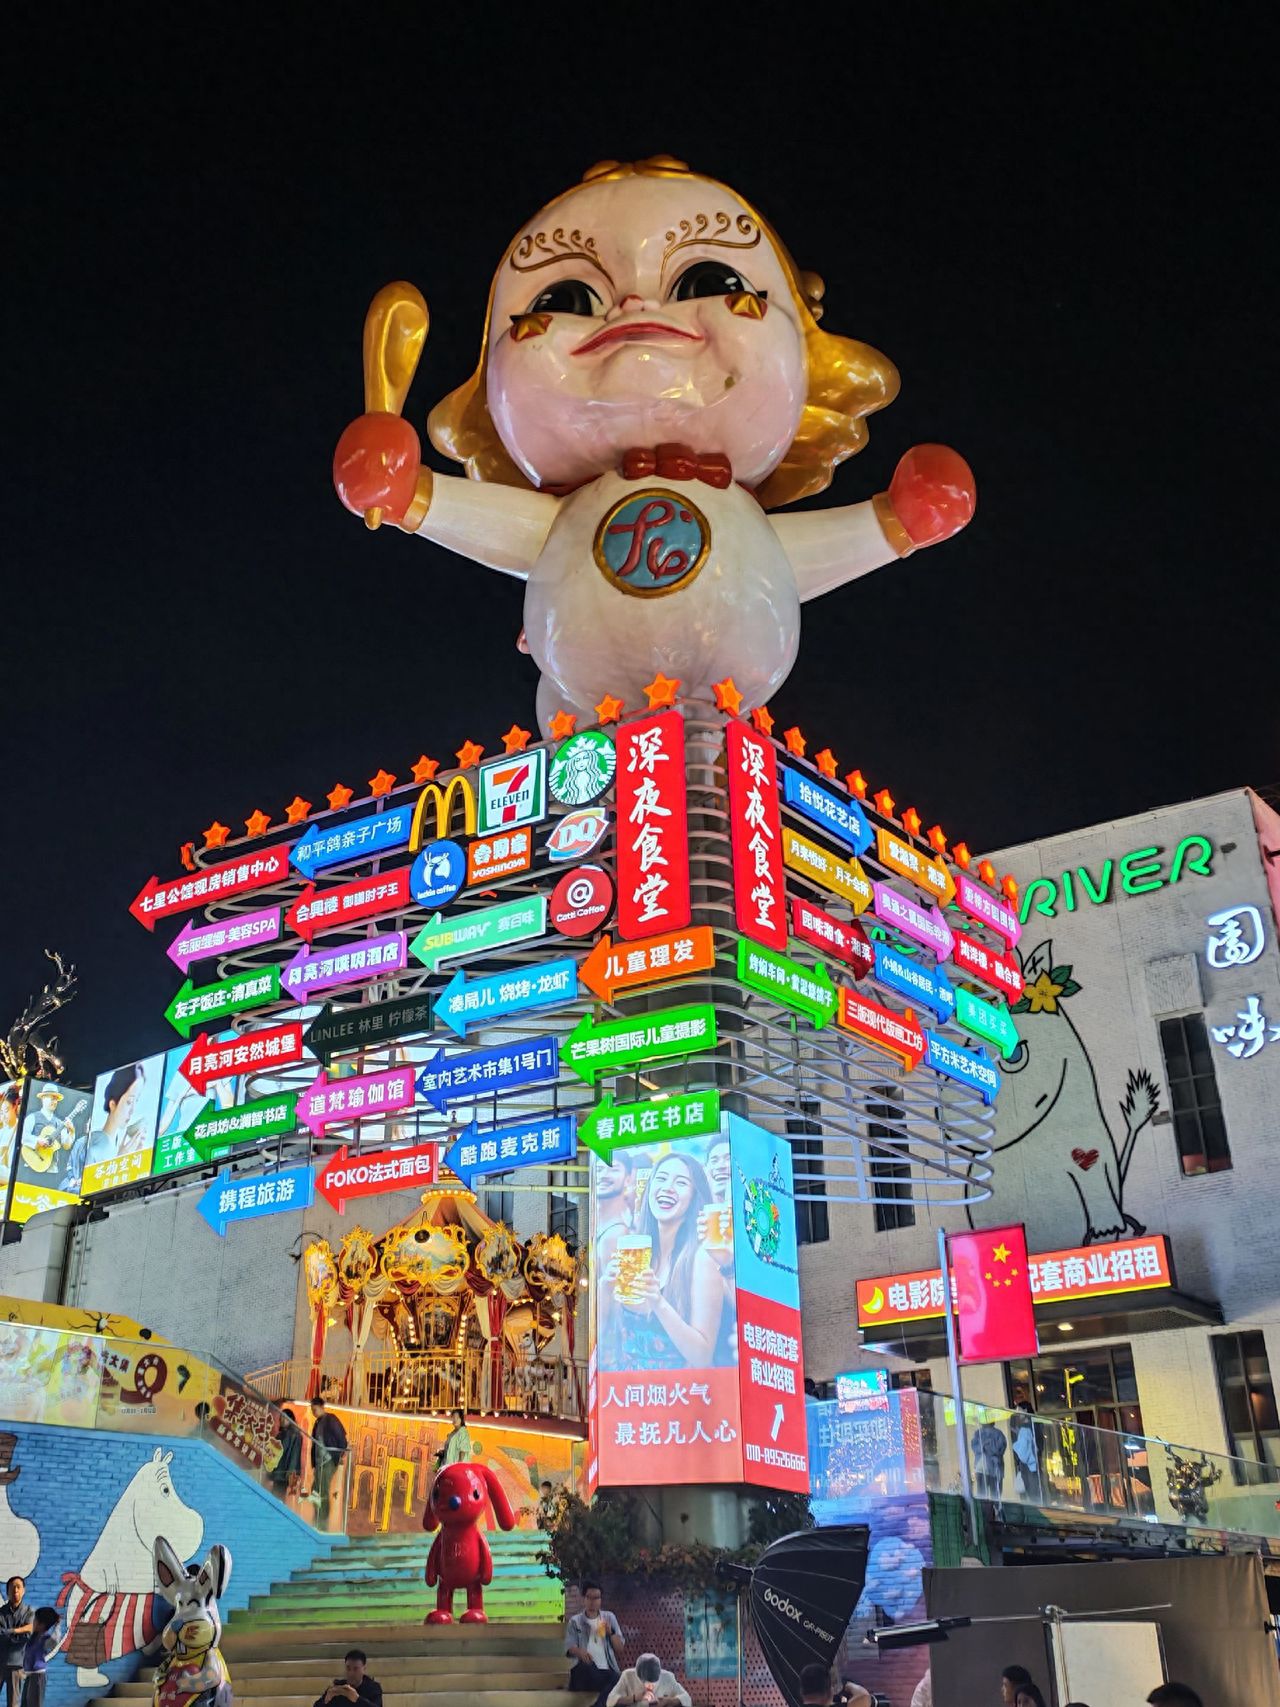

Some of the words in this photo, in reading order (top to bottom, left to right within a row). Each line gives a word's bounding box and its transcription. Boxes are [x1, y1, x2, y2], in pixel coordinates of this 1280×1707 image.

[626, 726, 673, 923] 深夜食堂
[799, 781, 862, 838] 拾悦花艺店
[296, 815, 402, 862] 和平鸽亲子广场
[558, 817, 598, 849] DQ
[741, 736, 776, 931] 深夜食堂
[139, 856, 280, 914] 七星公馆现房销售中心
[1019, 835, 1214, 925] RIVER
[423, 921, 492, 951] SUBWAY
[604, 938, 694, 980] 儿童理发
[499, 971, 570, 1001] 烧烤·龙虾
[310, 1022, 354, 1043] LINLEE
[358, 1015, 384, 1034] 林里
[388, 1004, 428, 1028] 柠檬茶
[570, 1017, 707, 1060] 芒果树国际儿童摄影
[847, 1000, 924, 1053] 三版现代版画工坊
[189, 1033, 296, 1076] 月亮河安然城堡
[422, 1049, 552, 1092] 室内艺术市集1号门
[309, 1078, 405, 1117] 道梵瑜伽馆
[596, 1101, 704, 1140] 春风在书店
[460, 1127, 560, 1167] 酷跑麦克斯
[325, 1154, 430, 1190] FOKO法式面包
[218, 1178, 295, 1215] 携程旅游
[743, 1321, 799, 1364] 电影院配套
[602, 1382, 711, 1408] 人间烟火气
[750, 1357, 797, 1396] 商业招租
[614, 1419, 737, 1446] 最抚凡人心
[763, 1587, 802, 1624] Godox
